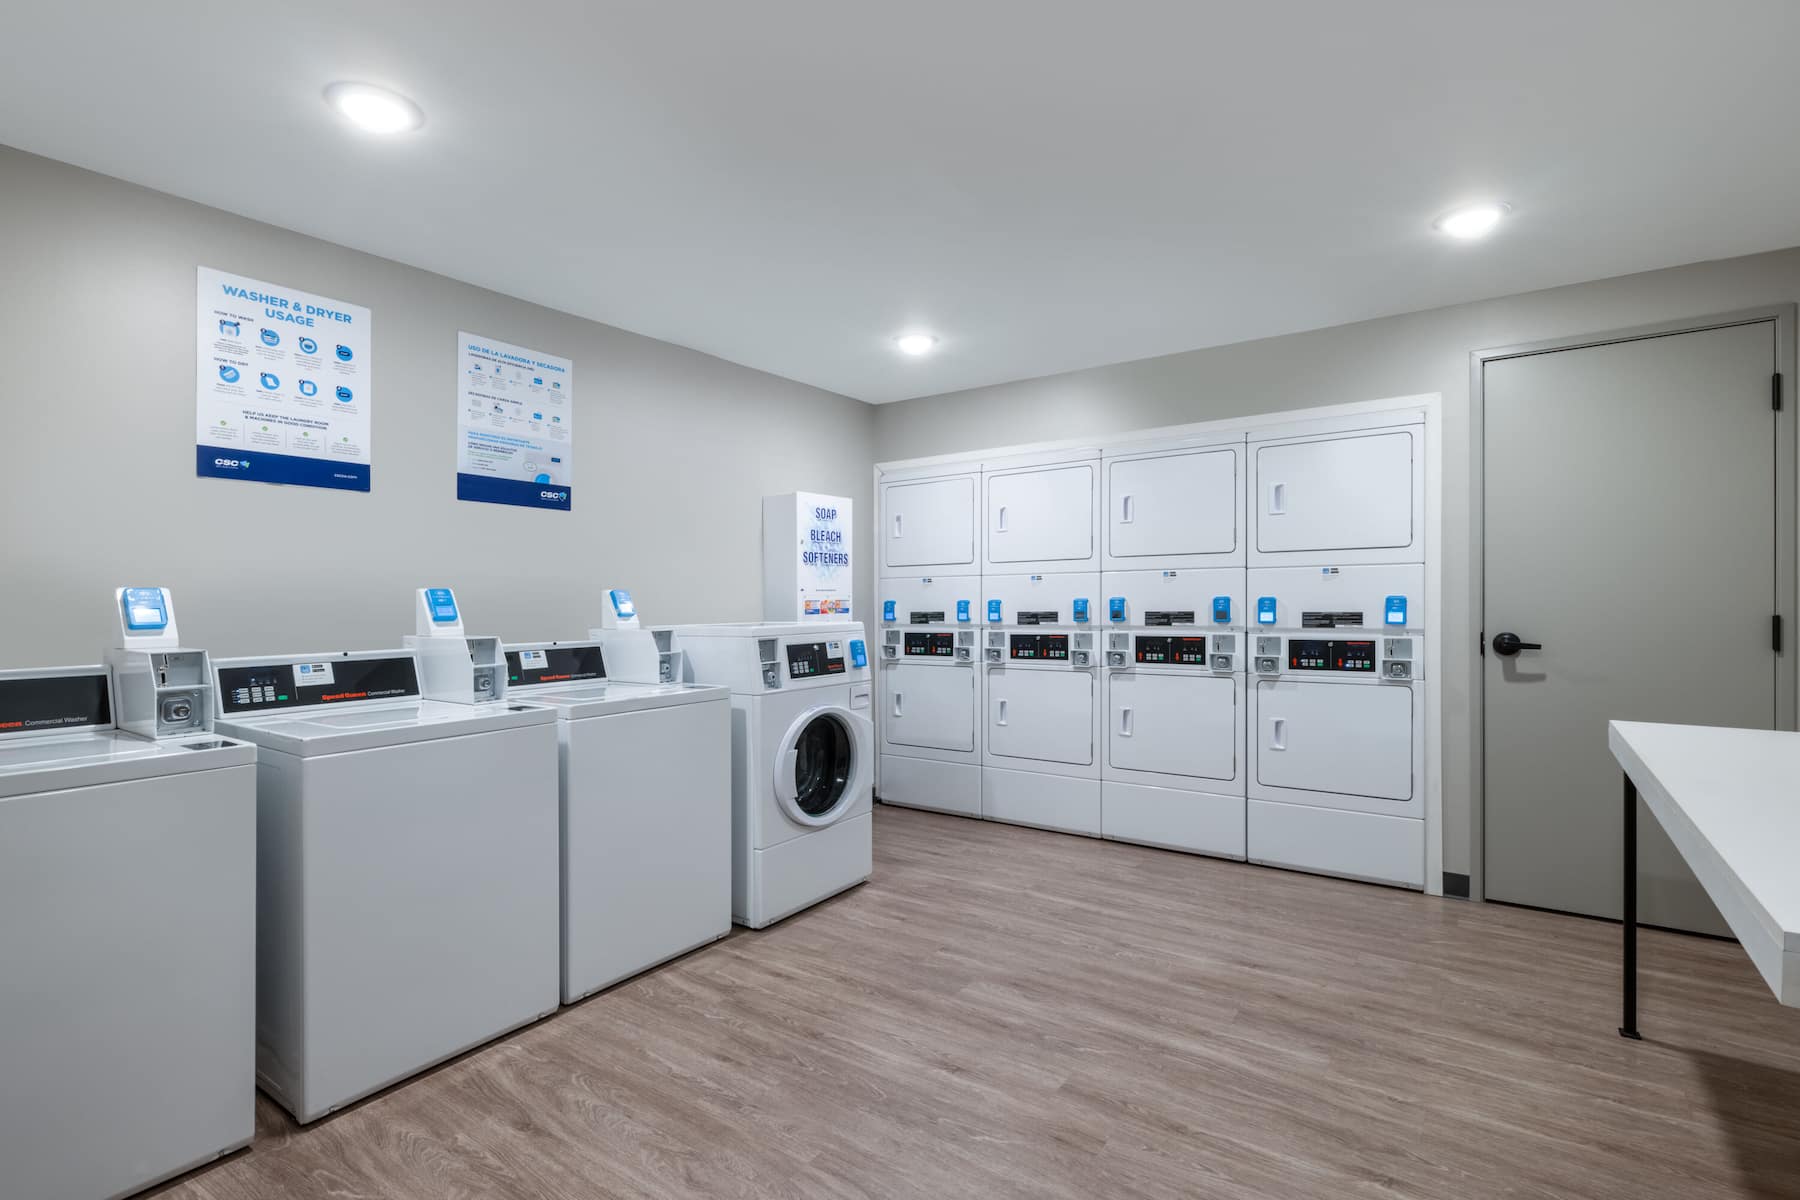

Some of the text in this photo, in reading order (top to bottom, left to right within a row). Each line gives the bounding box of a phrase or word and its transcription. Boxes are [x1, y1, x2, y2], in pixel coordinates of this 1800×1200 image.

[222, 284, 352, 324] WASHER & DRYER
[265, 308, 315, 327] USAGE
[468, 344, 481, 352] USO
[500, 352, 531, 364] LAVADORA
[214, 458, 239, 467] CSC
[540, 491, 559, 499] CSC
[815, 507, 837, 520] SOAP
[810, 529, 841, 543] BLEACH
[803, 551, 849, 565] SOFTENERS
[24, 718, 63, 726] Commercial
[63, 715, 88, 723] Washer
